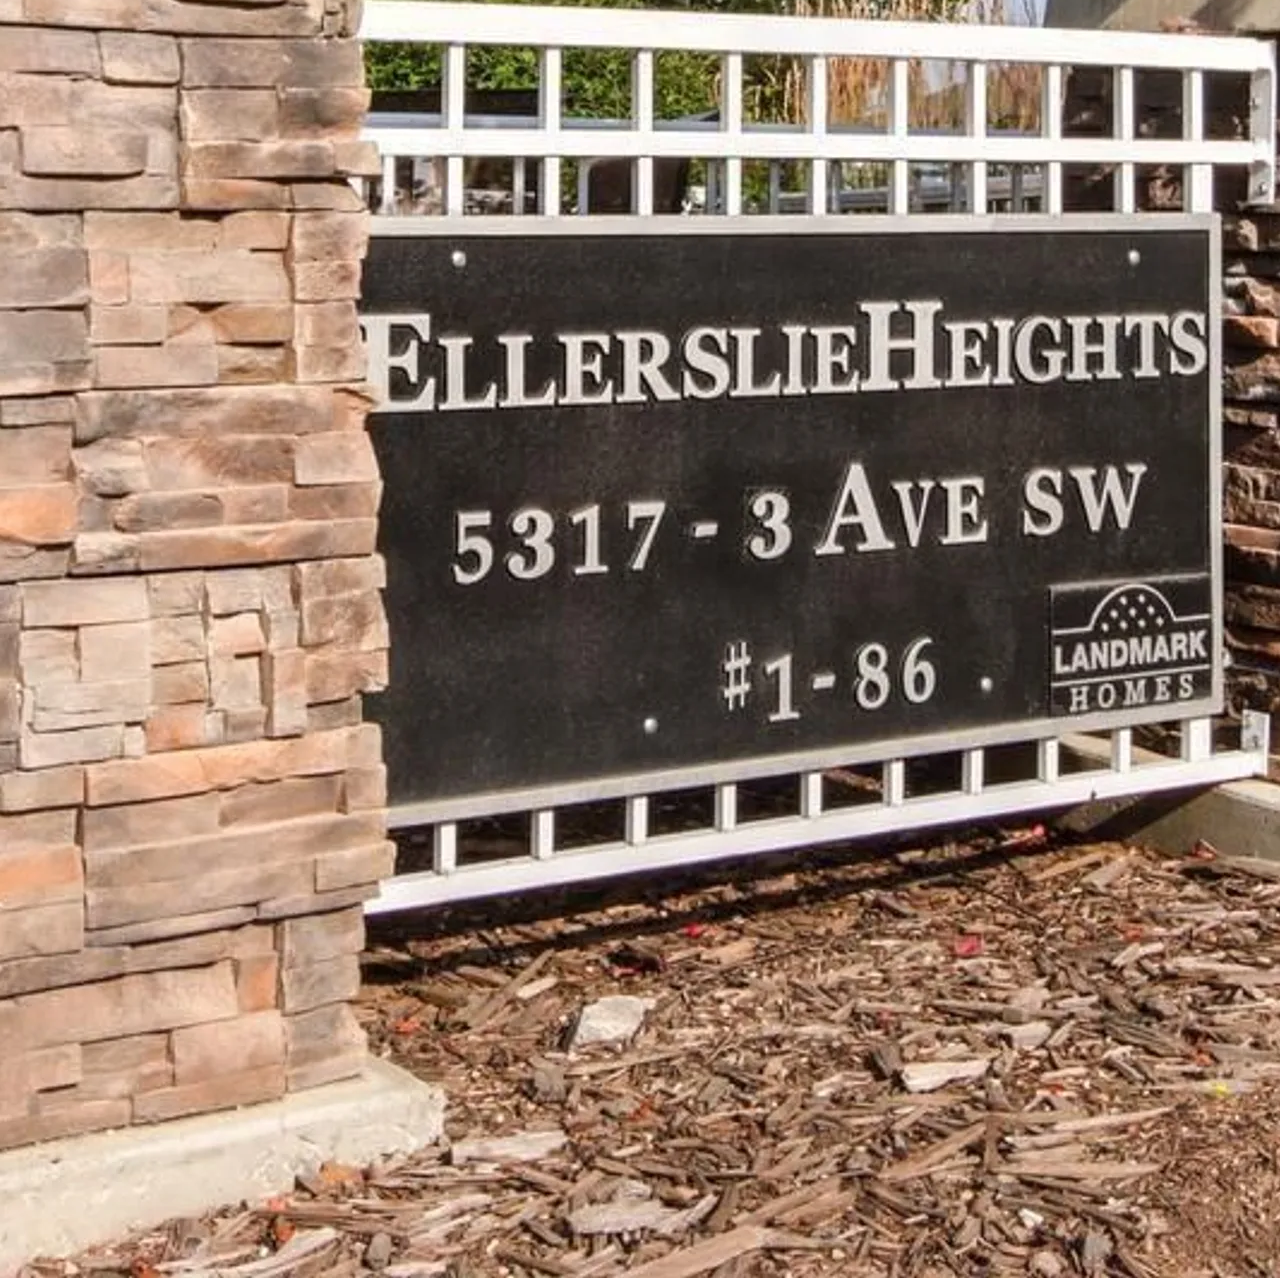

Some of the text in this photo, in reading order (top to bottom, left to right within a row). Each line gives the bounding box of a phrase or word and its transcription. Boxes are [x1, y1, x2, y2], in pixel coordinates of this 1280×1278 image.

[453, 501, 666, 585] 5317
[749, 492, 793, 559] 3
[1023, 462, 1148, 537] SW
[1054, 629, 1208, 674] LANDMARK
[1069, 673, 1194, 713] HOMES
